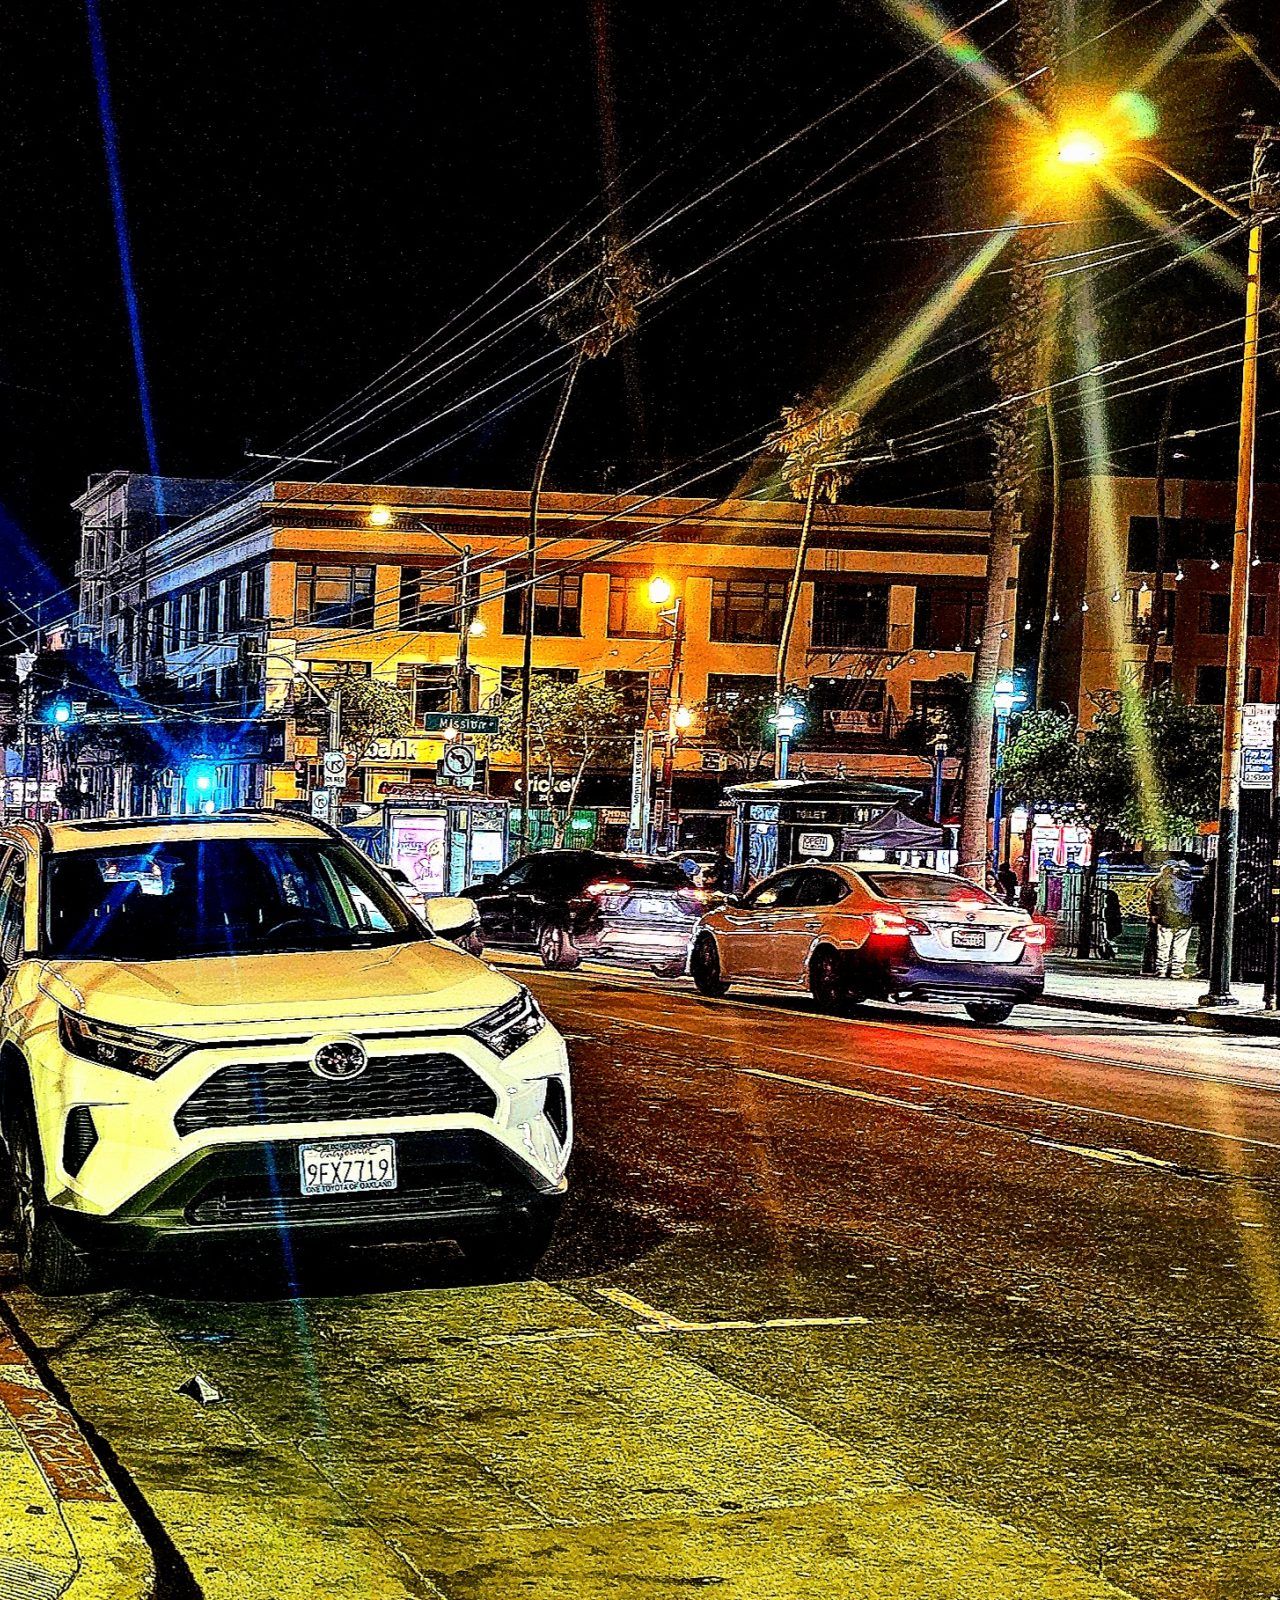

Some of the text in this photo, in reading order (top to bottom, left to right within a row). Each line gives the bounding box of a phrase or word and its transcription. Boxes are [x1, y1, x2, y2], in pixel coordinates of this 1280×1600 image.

[440, 717, 486, 730] Mission
[796, 810, 827, 819] TOILET
[307, 1158, 389, 1187] 9FXZ719
[322, 1183, 349, 1192] TOYOTA
[360, 1180, 392, 1189] OAKLAND
